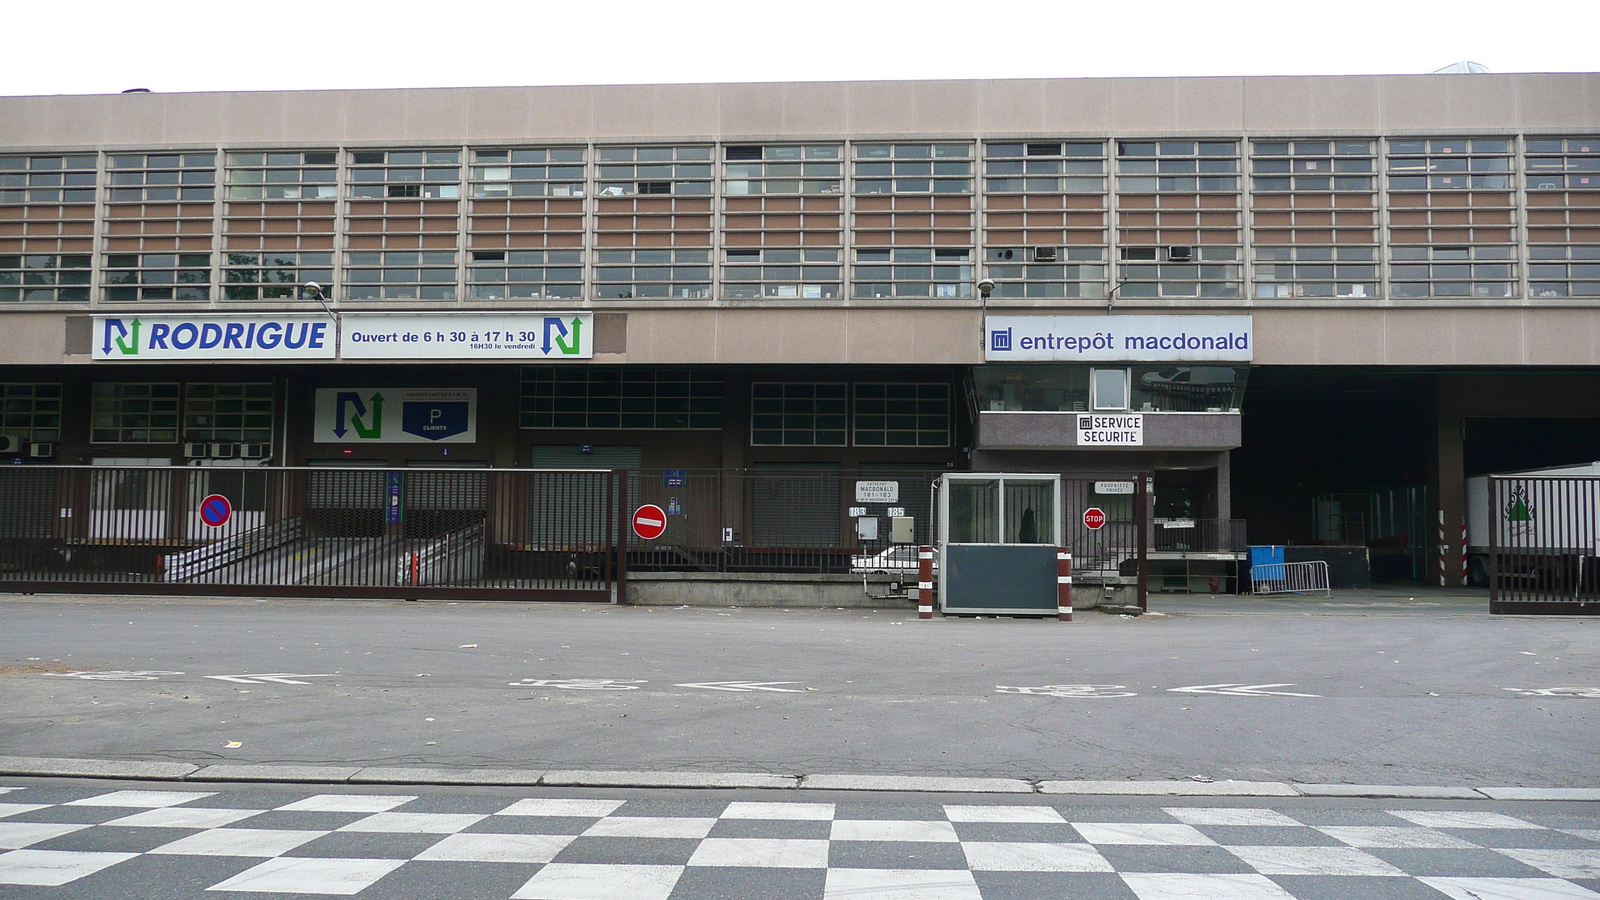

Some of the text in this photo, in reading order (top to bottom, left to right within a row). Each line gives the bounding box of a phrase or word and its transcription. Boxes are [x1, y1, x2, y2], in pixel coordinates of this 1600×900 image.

[148, 322, 328, 350] RODRIGUE
[351, 331, 536, 343] Ouvert de 6 h 30 à 17 h 30
[1020, 332, 1114, 353] entrepôt
[1124, 332, 1249, 350] macdonald
[430, 409, 442, 424] P
[1094, 417, 1141, 428] SERVICE
[849, 507, 866, 516] 183
[888, 507, 905, 517] 185
